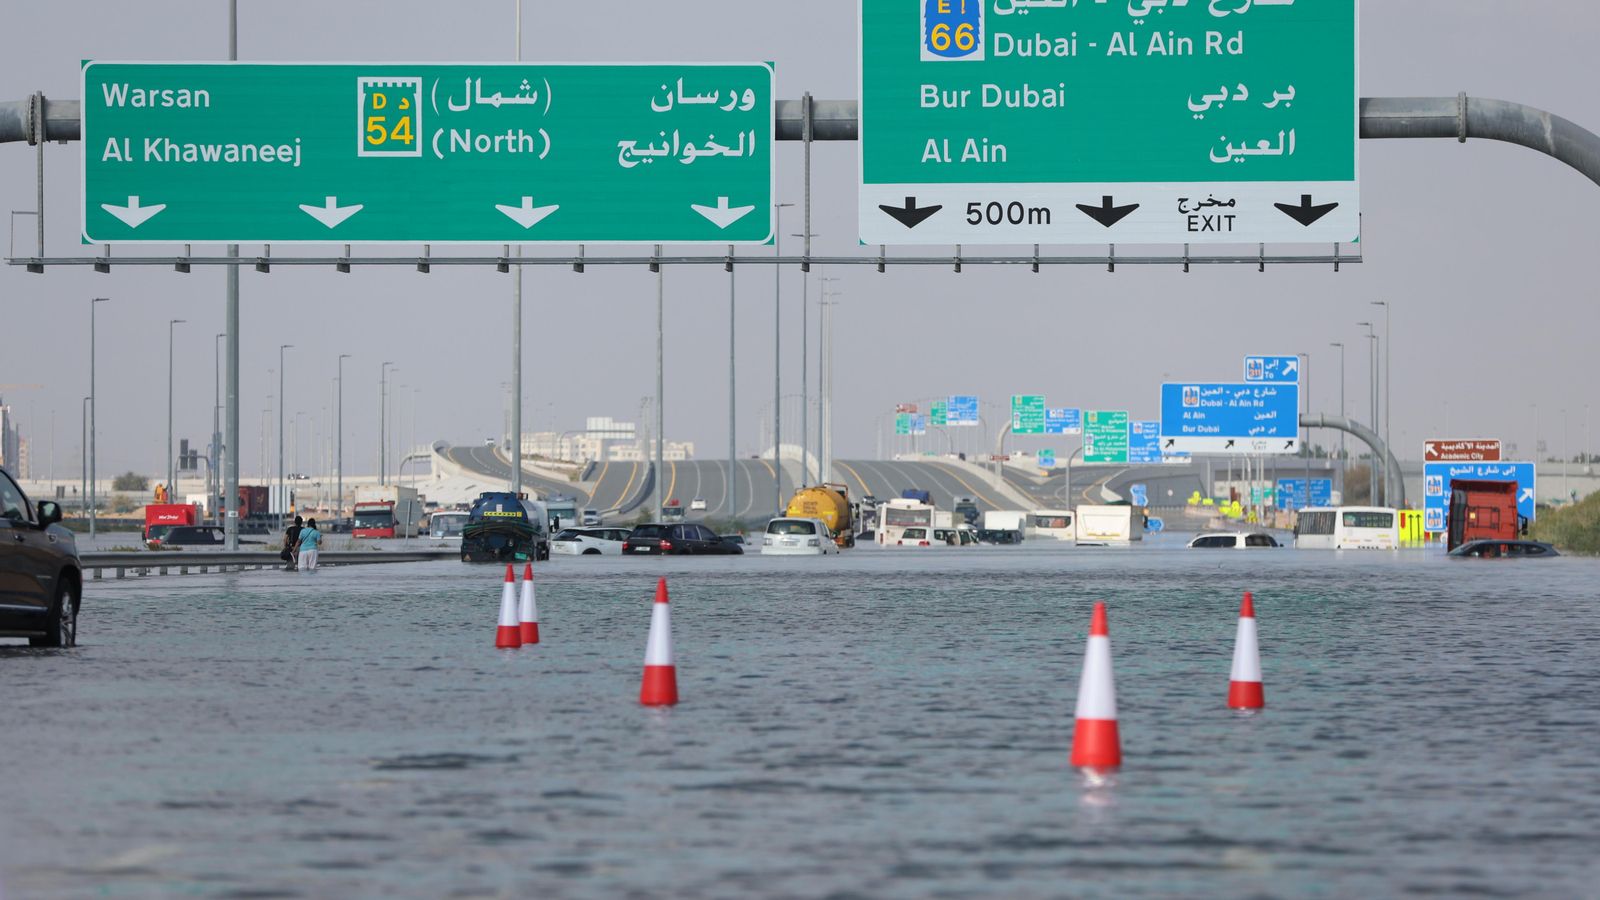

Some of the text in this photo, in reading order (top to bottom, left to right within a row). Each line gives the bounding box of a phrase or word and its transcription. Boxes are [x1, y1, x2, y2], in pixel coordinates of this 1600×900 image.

[931, 23, 975, 51] 66
[995, 32, 1076, 56] Dubai
[1107, 32, 1137, 55] Al
[1147, 31, 1192, 55] Ain
[1206, 31, 1243, 55] Rd
[103, 84, 210, 108] Warsan
[372, 94, 387, 110] D
[398, 98, 410, 110] د
[651, 78, 756, 113] ورسان
[921, 83, 1064, 107] Bur Dubai
[1188, 83, 1296, 120] بر دبي
[366, 117, 414, 145] 54
[103, 138, 302, 167] Al Khawaneej
[433, 128, 551, 160] (North)
[617, 130, 756, 167] الخوانيج
[922, 138, 1007, 162] Al Ain
[1209, 129, 1296, 163] العين
[967, 201, 1050, 225] 500m
[1178, 194, 1236, 214] مخرج
[1187, 214, 1236, 232] EXIT
[1265, 371, 1274, 379] To
[1183, 411, 1205, 419] Al Ain
[1201, 399, 1222, 407] Dubai
